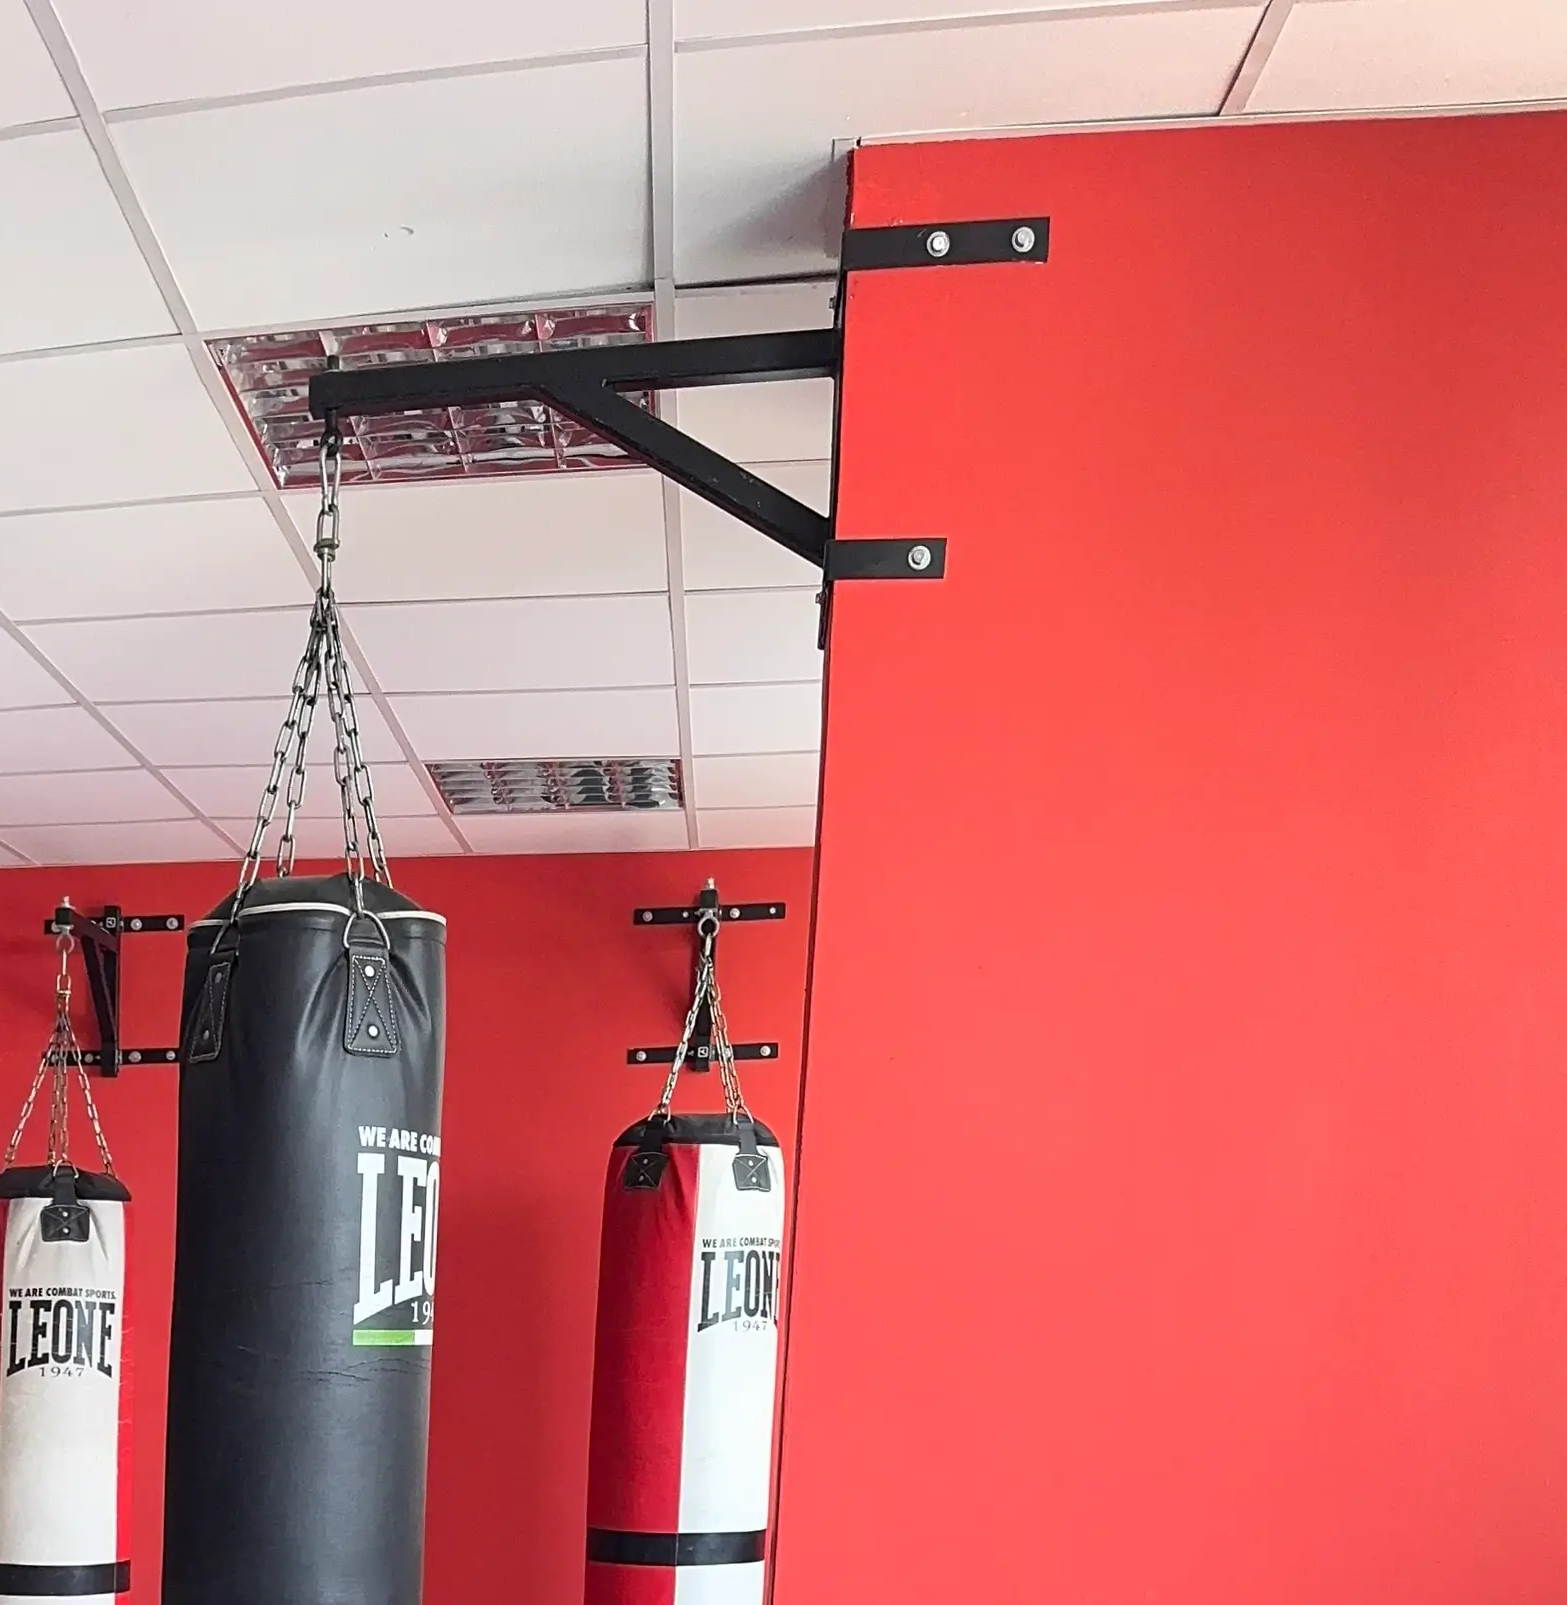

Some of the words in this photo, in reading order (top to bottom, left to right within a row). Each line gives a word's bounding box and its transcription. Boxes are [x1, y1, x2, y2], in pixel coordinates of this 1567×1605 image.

[358, 1125, 386, 1148] WE
[389, 1127, 417, 1152] ARE
[353, 1152, 440, 1325] LEO
[702, 1238, 717, 1248] WE
[719, 1238, 737, 1248] ARE
[739, 1237, 767, 1246] COMBAT
[9, 1288, 23, 1298] WE
[25, 1288, 43, 1297] ARE
[46, 1287, 83, 1297] COMBAT
[733, 1320, 768, 1332] 1947
[6, 1299, 115, 1378] LEONE
[39, 1367, 84, 1377] 1947
